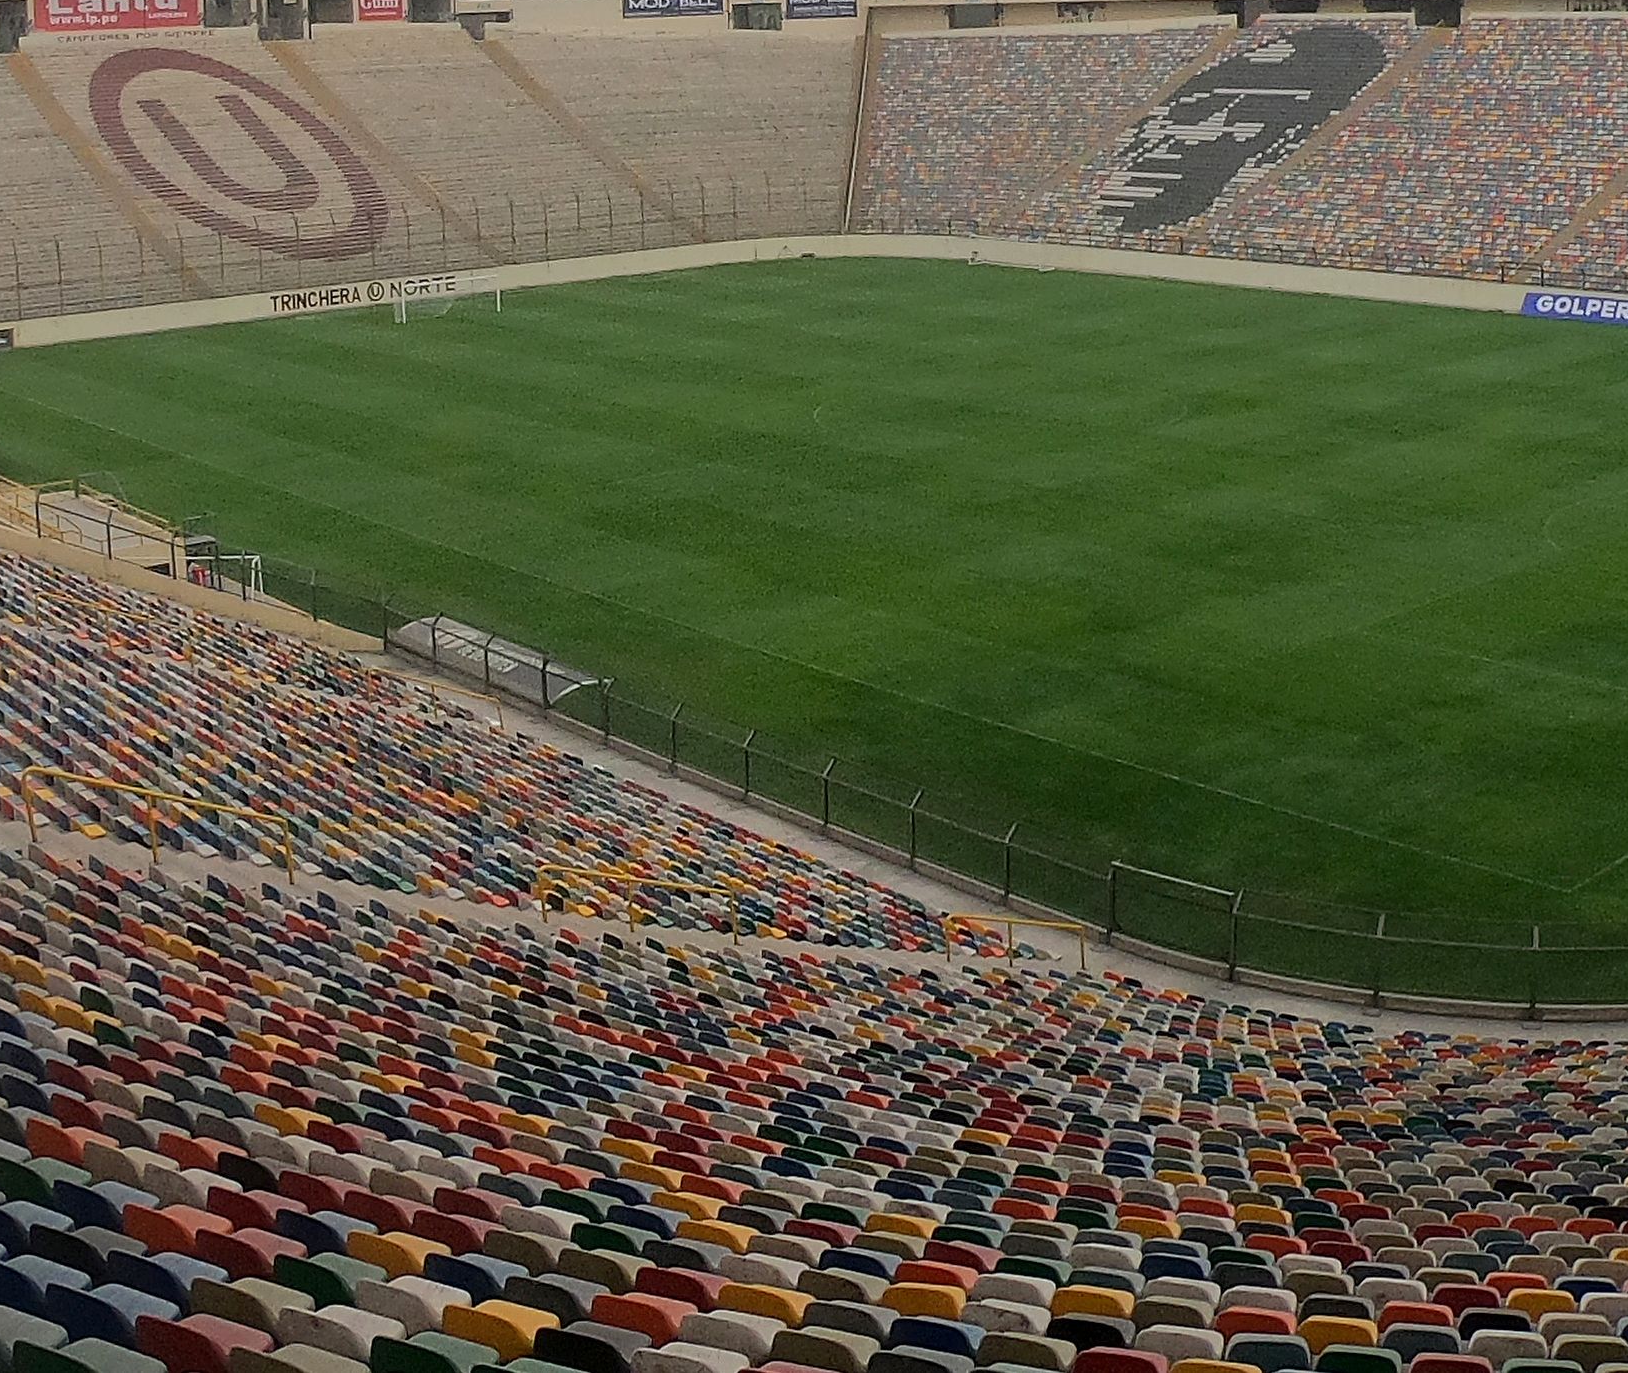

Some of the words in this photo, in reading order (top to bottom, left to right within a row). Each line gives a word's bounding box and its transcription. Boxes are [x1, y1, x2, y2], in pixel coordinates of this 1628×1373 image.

[49, 13, 118, 26] www.lp.pe
[270, 287, 361, 312] TRINCHERA
[390, 276, 456, 298] NORTE
